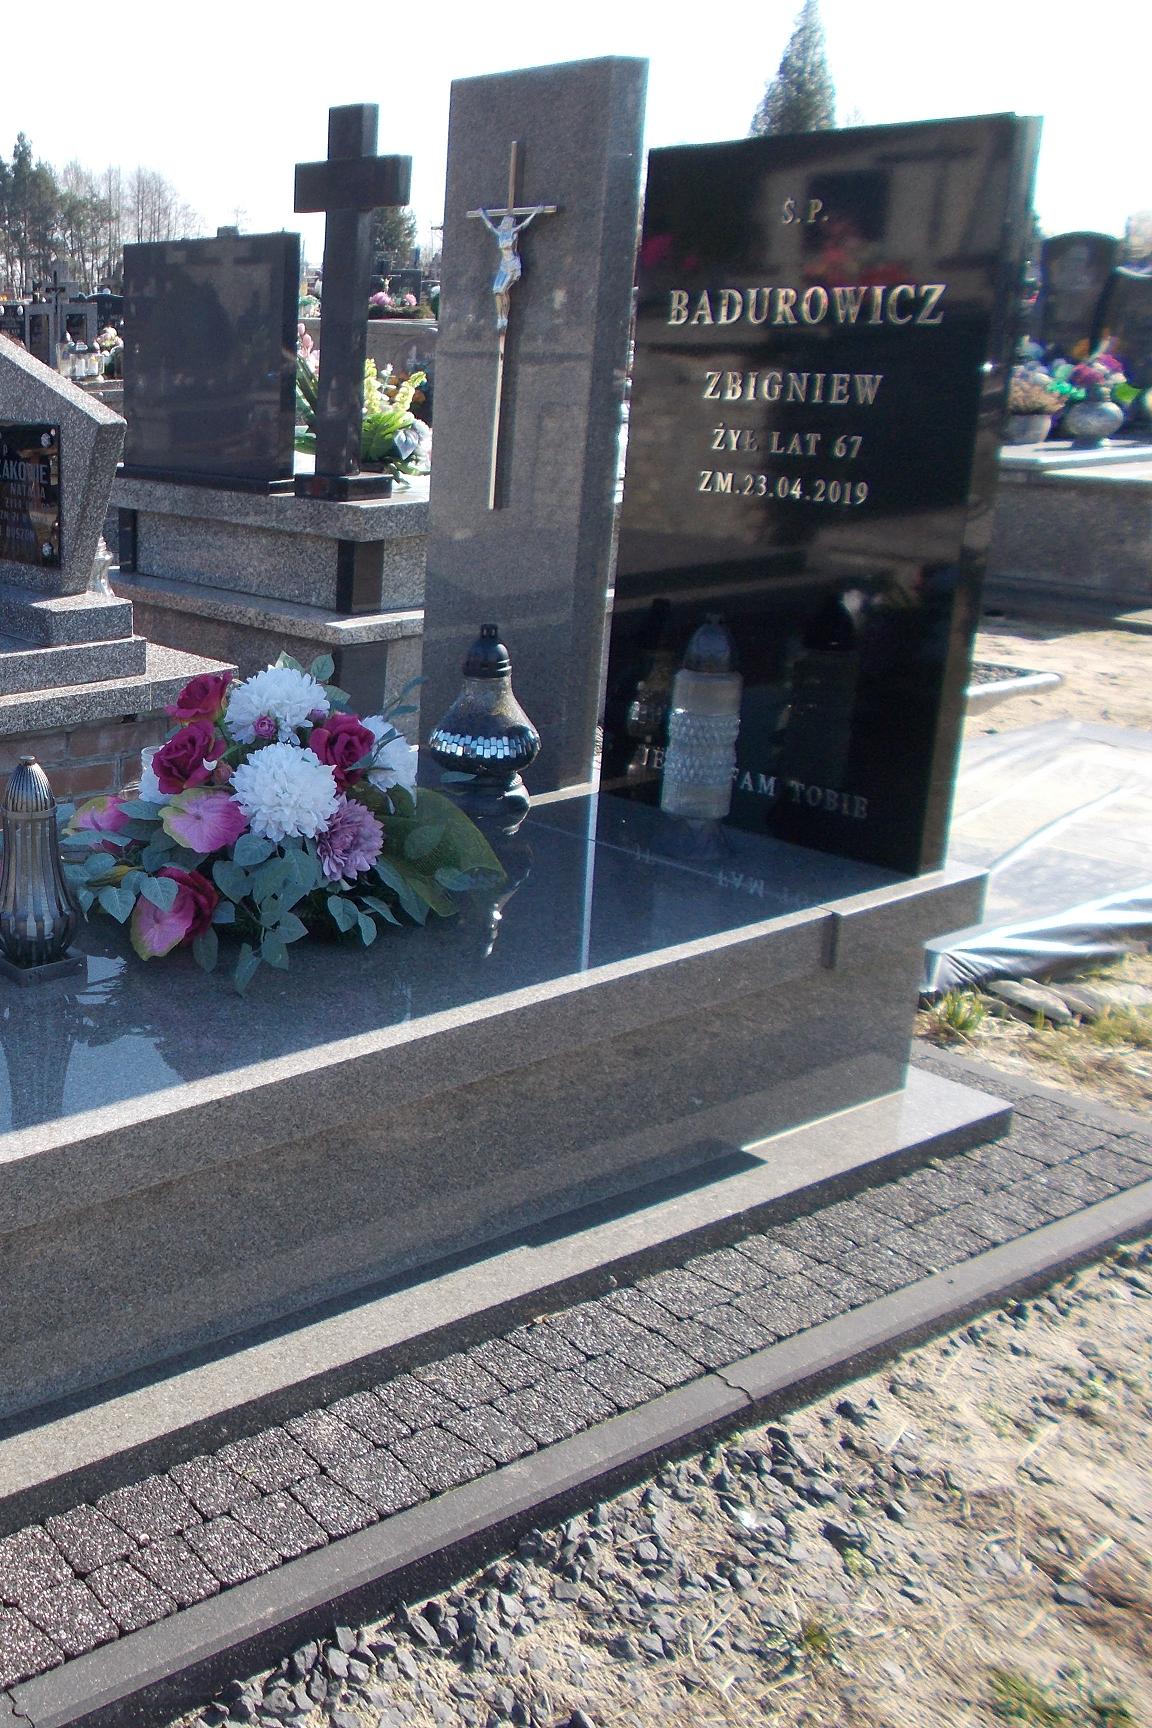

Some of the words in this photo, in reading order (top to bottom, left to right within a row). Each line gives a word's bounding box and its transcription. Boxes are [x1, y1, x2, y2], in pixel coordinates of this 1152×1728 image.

[667, 284, 948, 326] BADUROWICZ
[703, 370, 884, 405] ZBIGNIEW
[770, 431, 822, 456] LAT
[834, 434, 863, 458] 67
[788, 779, 868, 819] TOBIE
